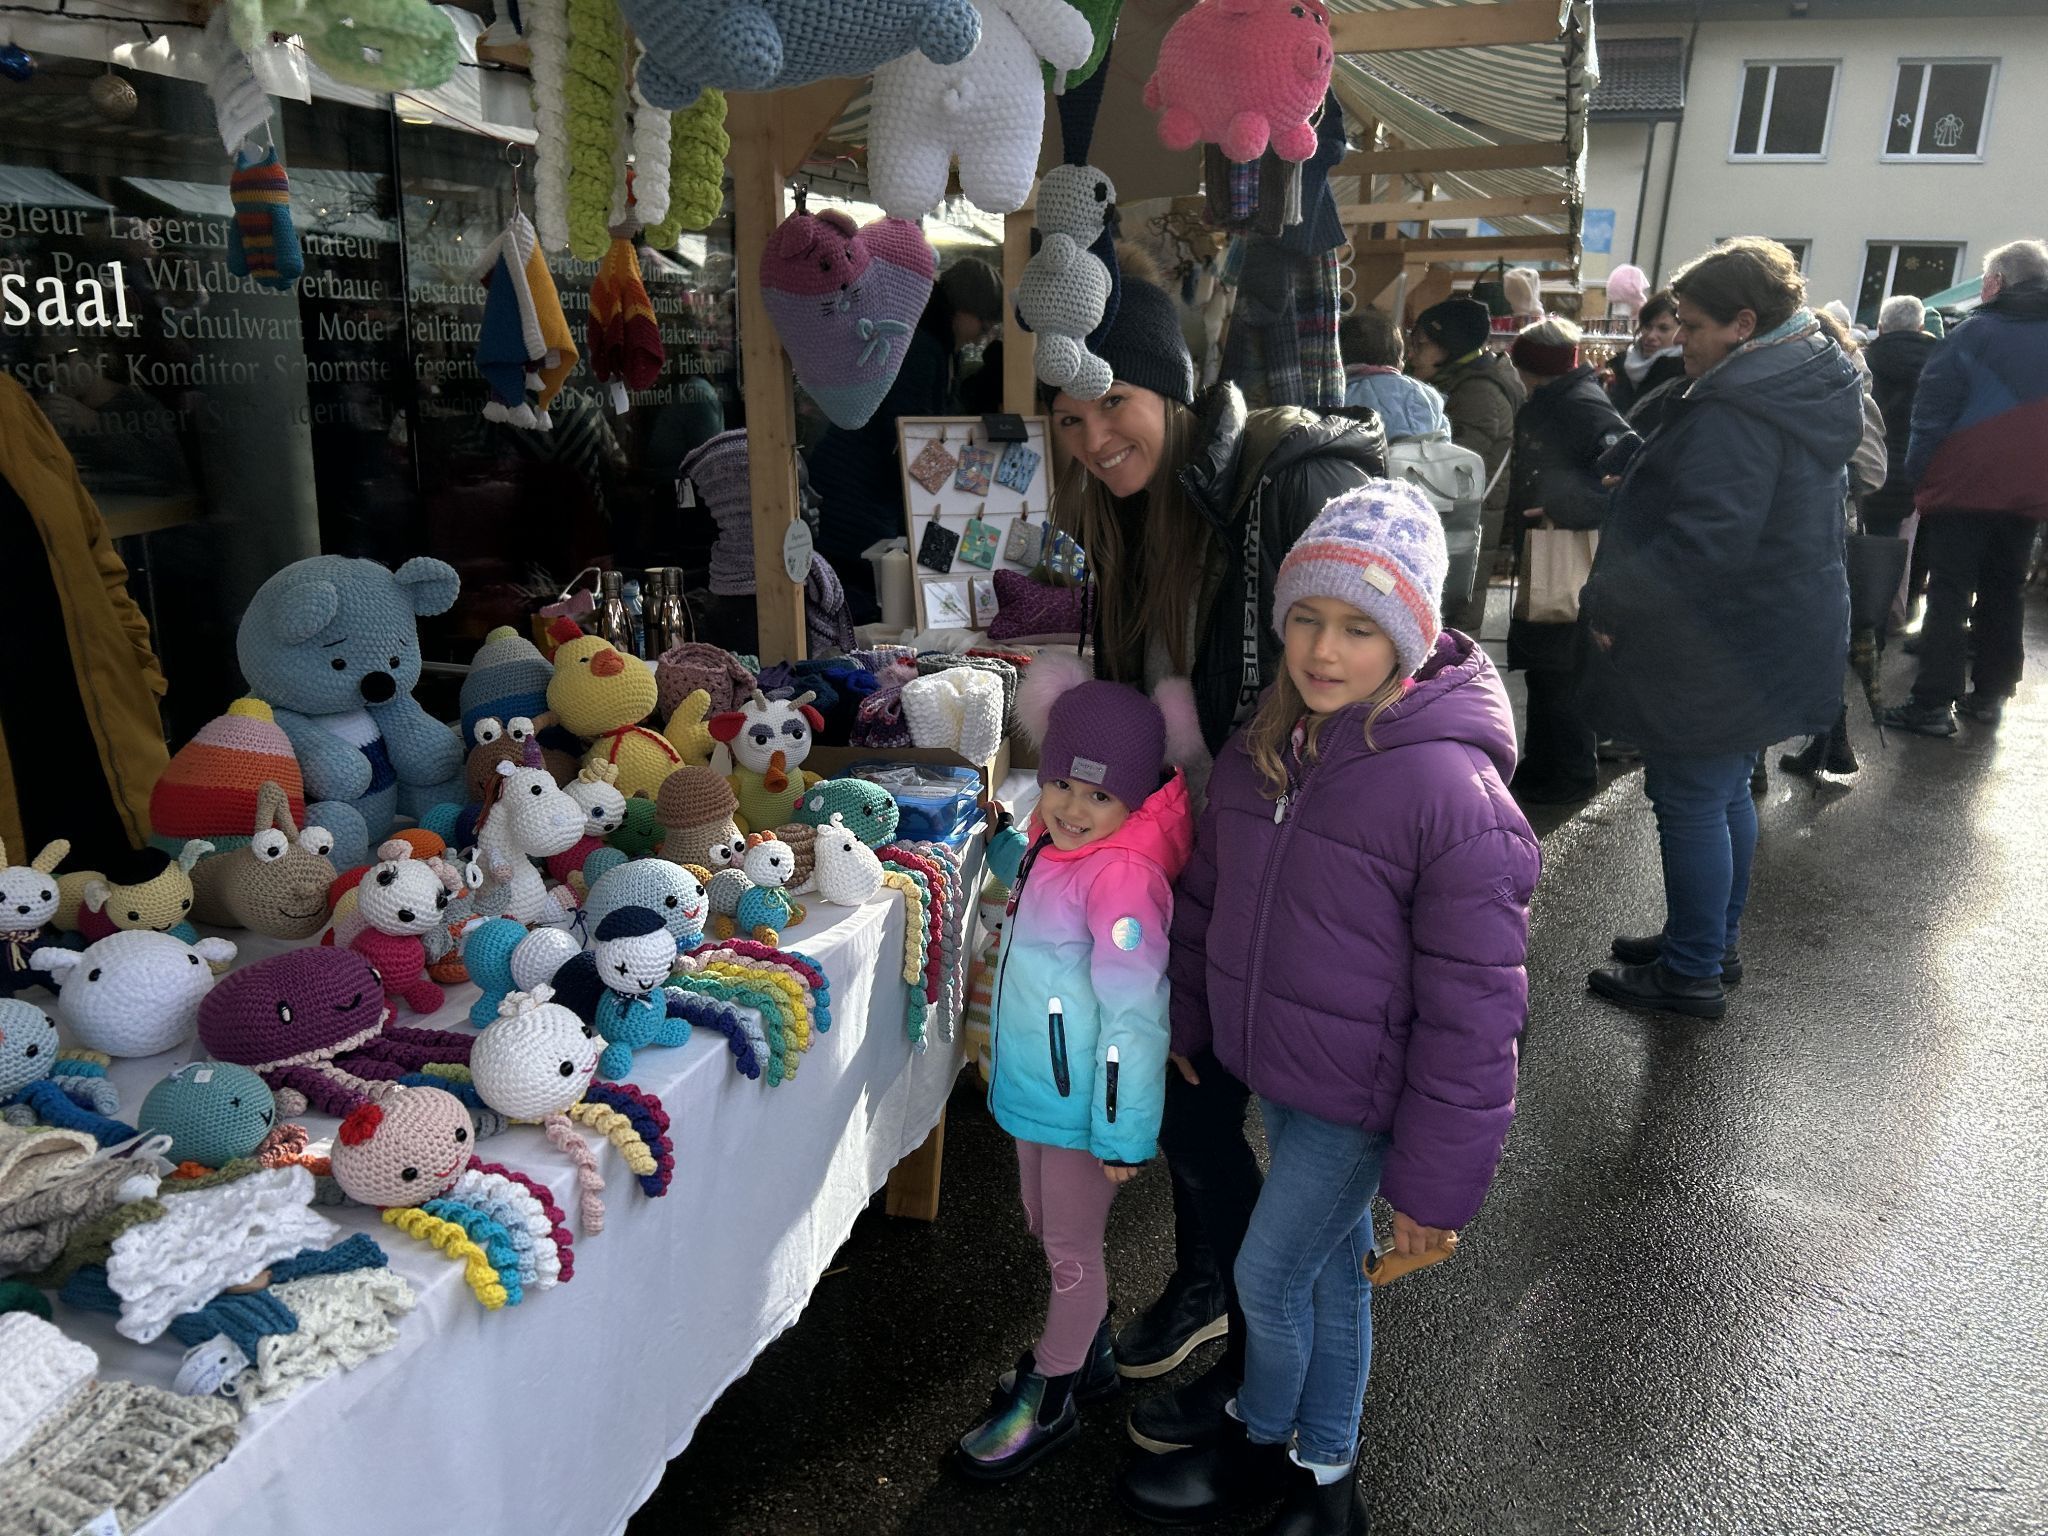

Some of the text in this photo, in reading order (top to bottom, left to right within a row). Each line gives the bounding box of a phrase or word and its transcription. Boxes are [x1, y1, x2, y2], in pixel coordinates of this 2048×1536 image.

[1, 260, 134, 327] saal
[162, 306, 304, 340] Schulwart
[125, 353, 259, 387] Konditor
